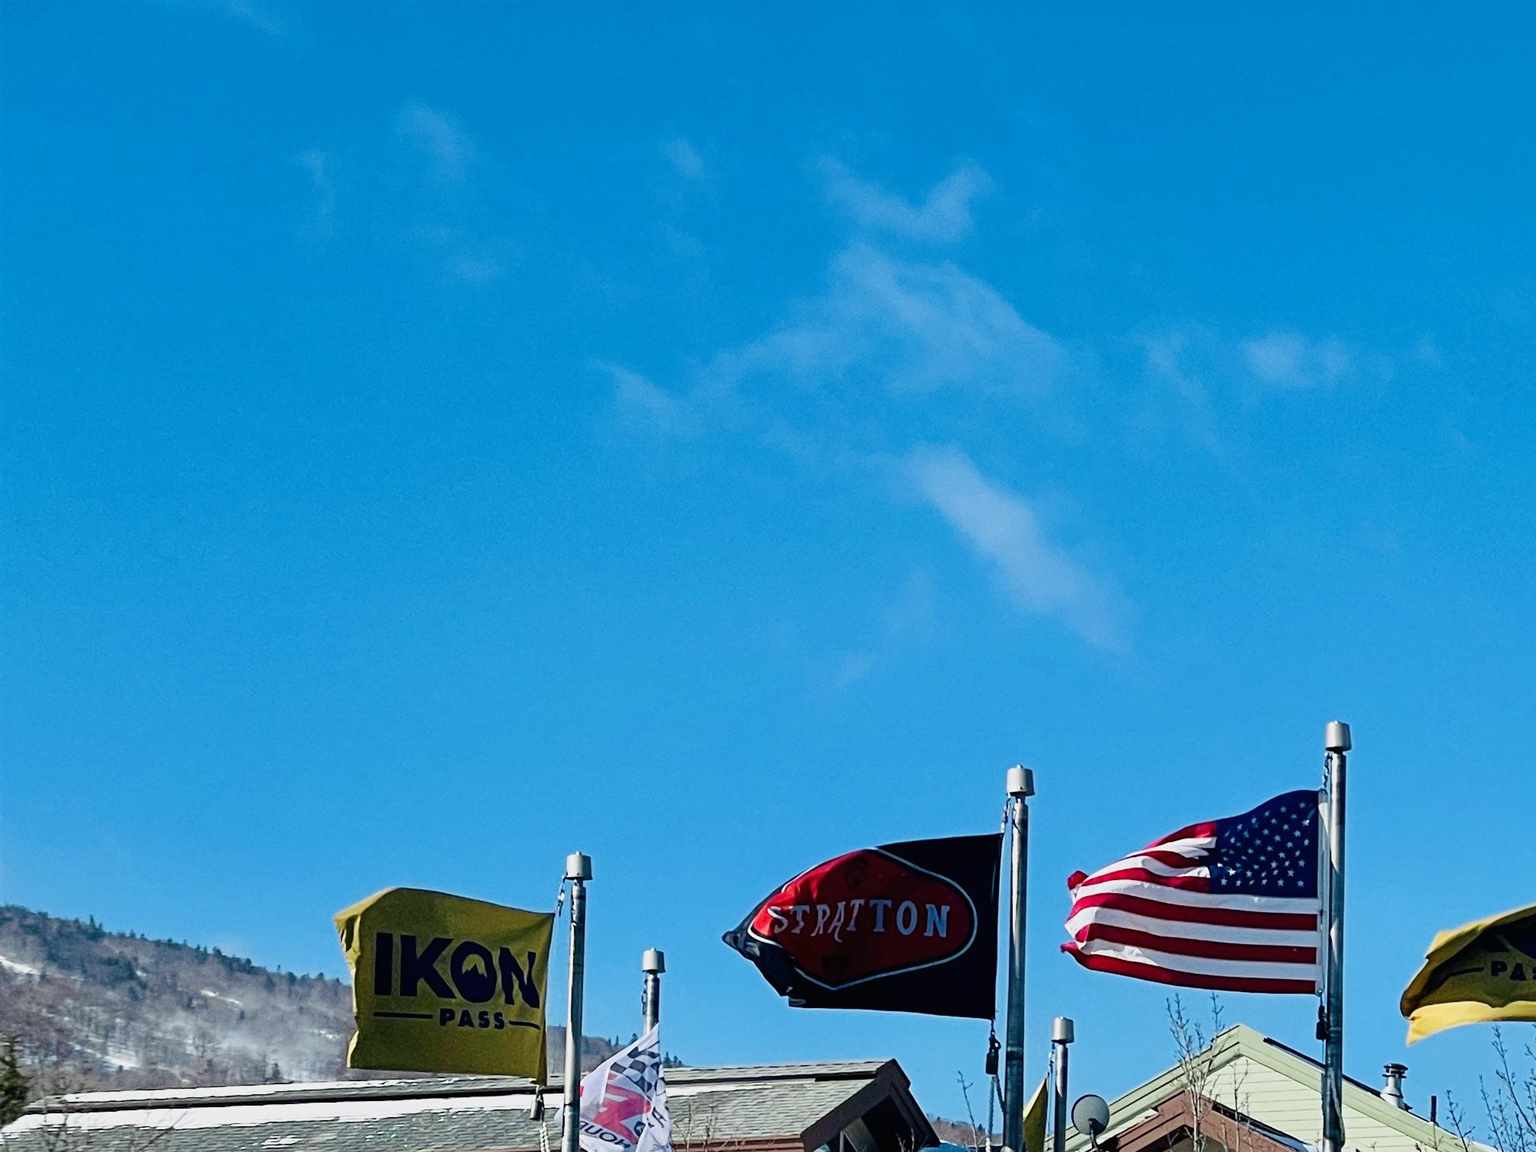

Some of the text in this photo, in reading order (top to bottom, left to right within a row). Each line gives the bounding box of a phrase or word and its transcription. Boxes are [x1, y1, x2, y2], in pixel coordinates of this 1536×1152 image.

[766, 900, 951, 943] STRATTON
[374, 932, 541, 1009] IKON
[438, 1007, 506, 1030] PASS
